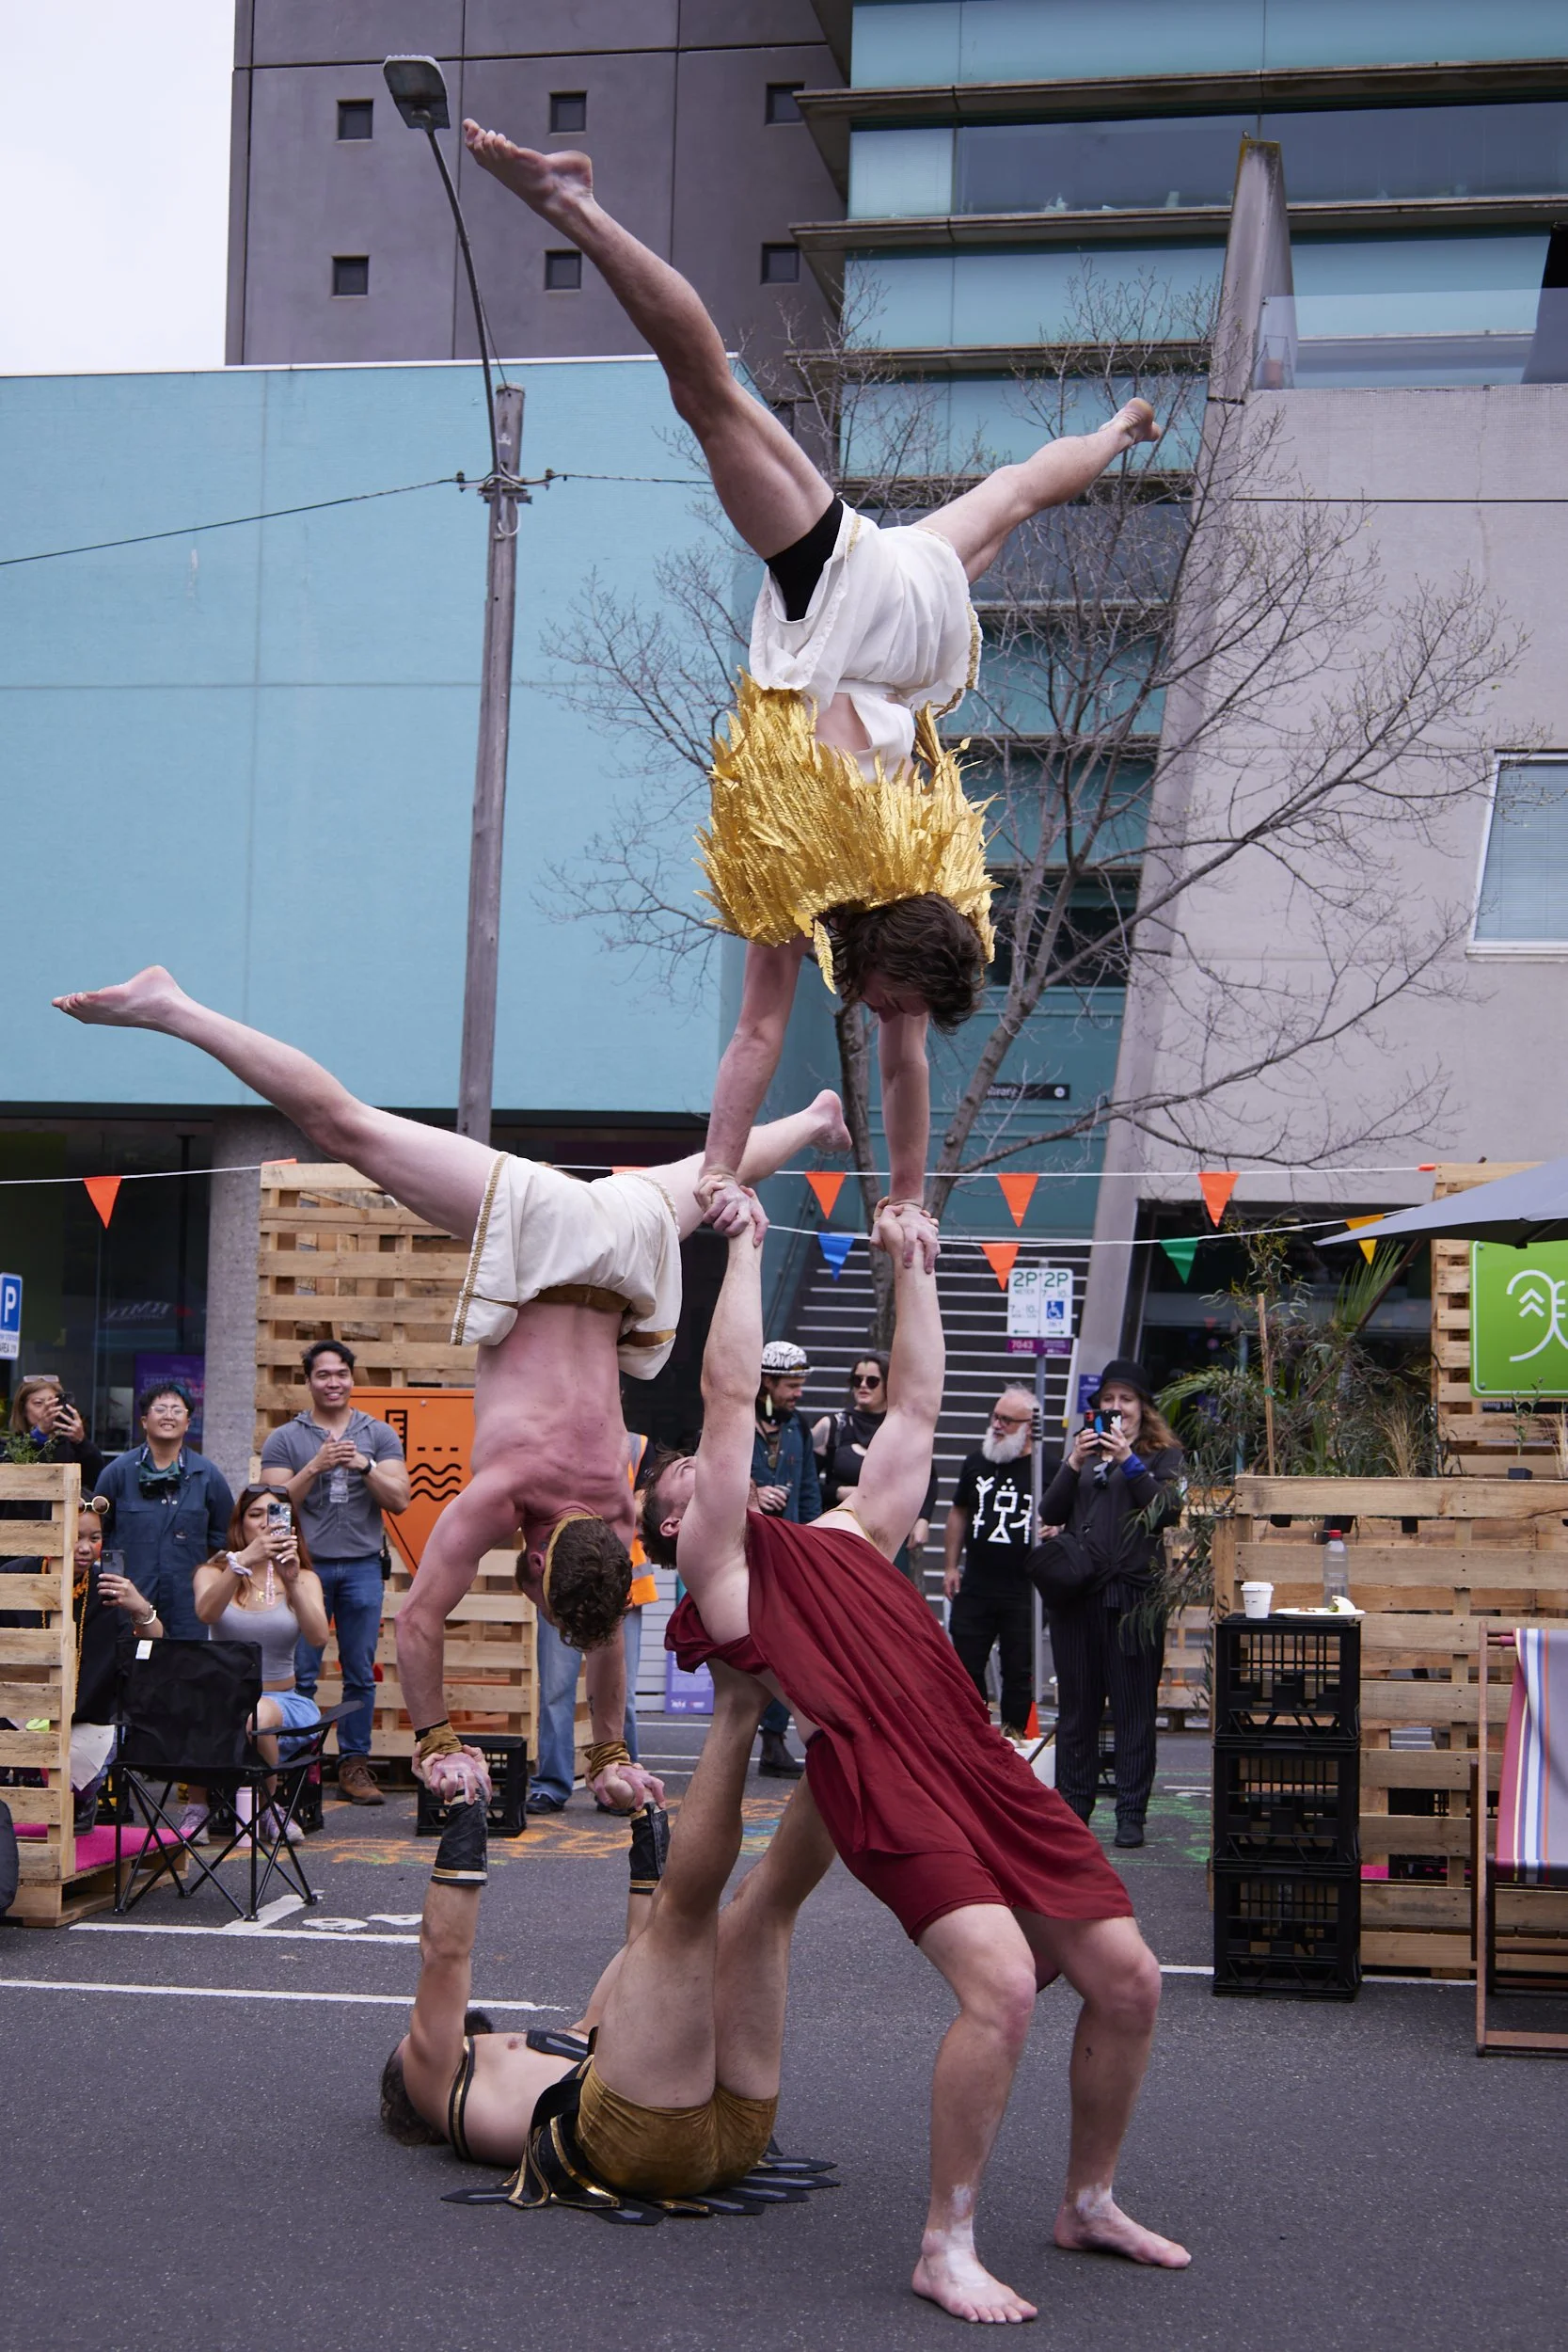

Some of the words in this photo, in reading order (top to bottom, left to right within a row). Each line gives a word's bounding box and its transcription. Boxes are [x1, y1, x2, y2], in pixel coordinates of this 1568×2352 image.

[1013, 1272, 1037, 1287] 2P
[1044, 1272, 1069, 1288] 2P
[4, 1285, 17, 1323] P
[1011, 1340, 1034, 1349] 7043
